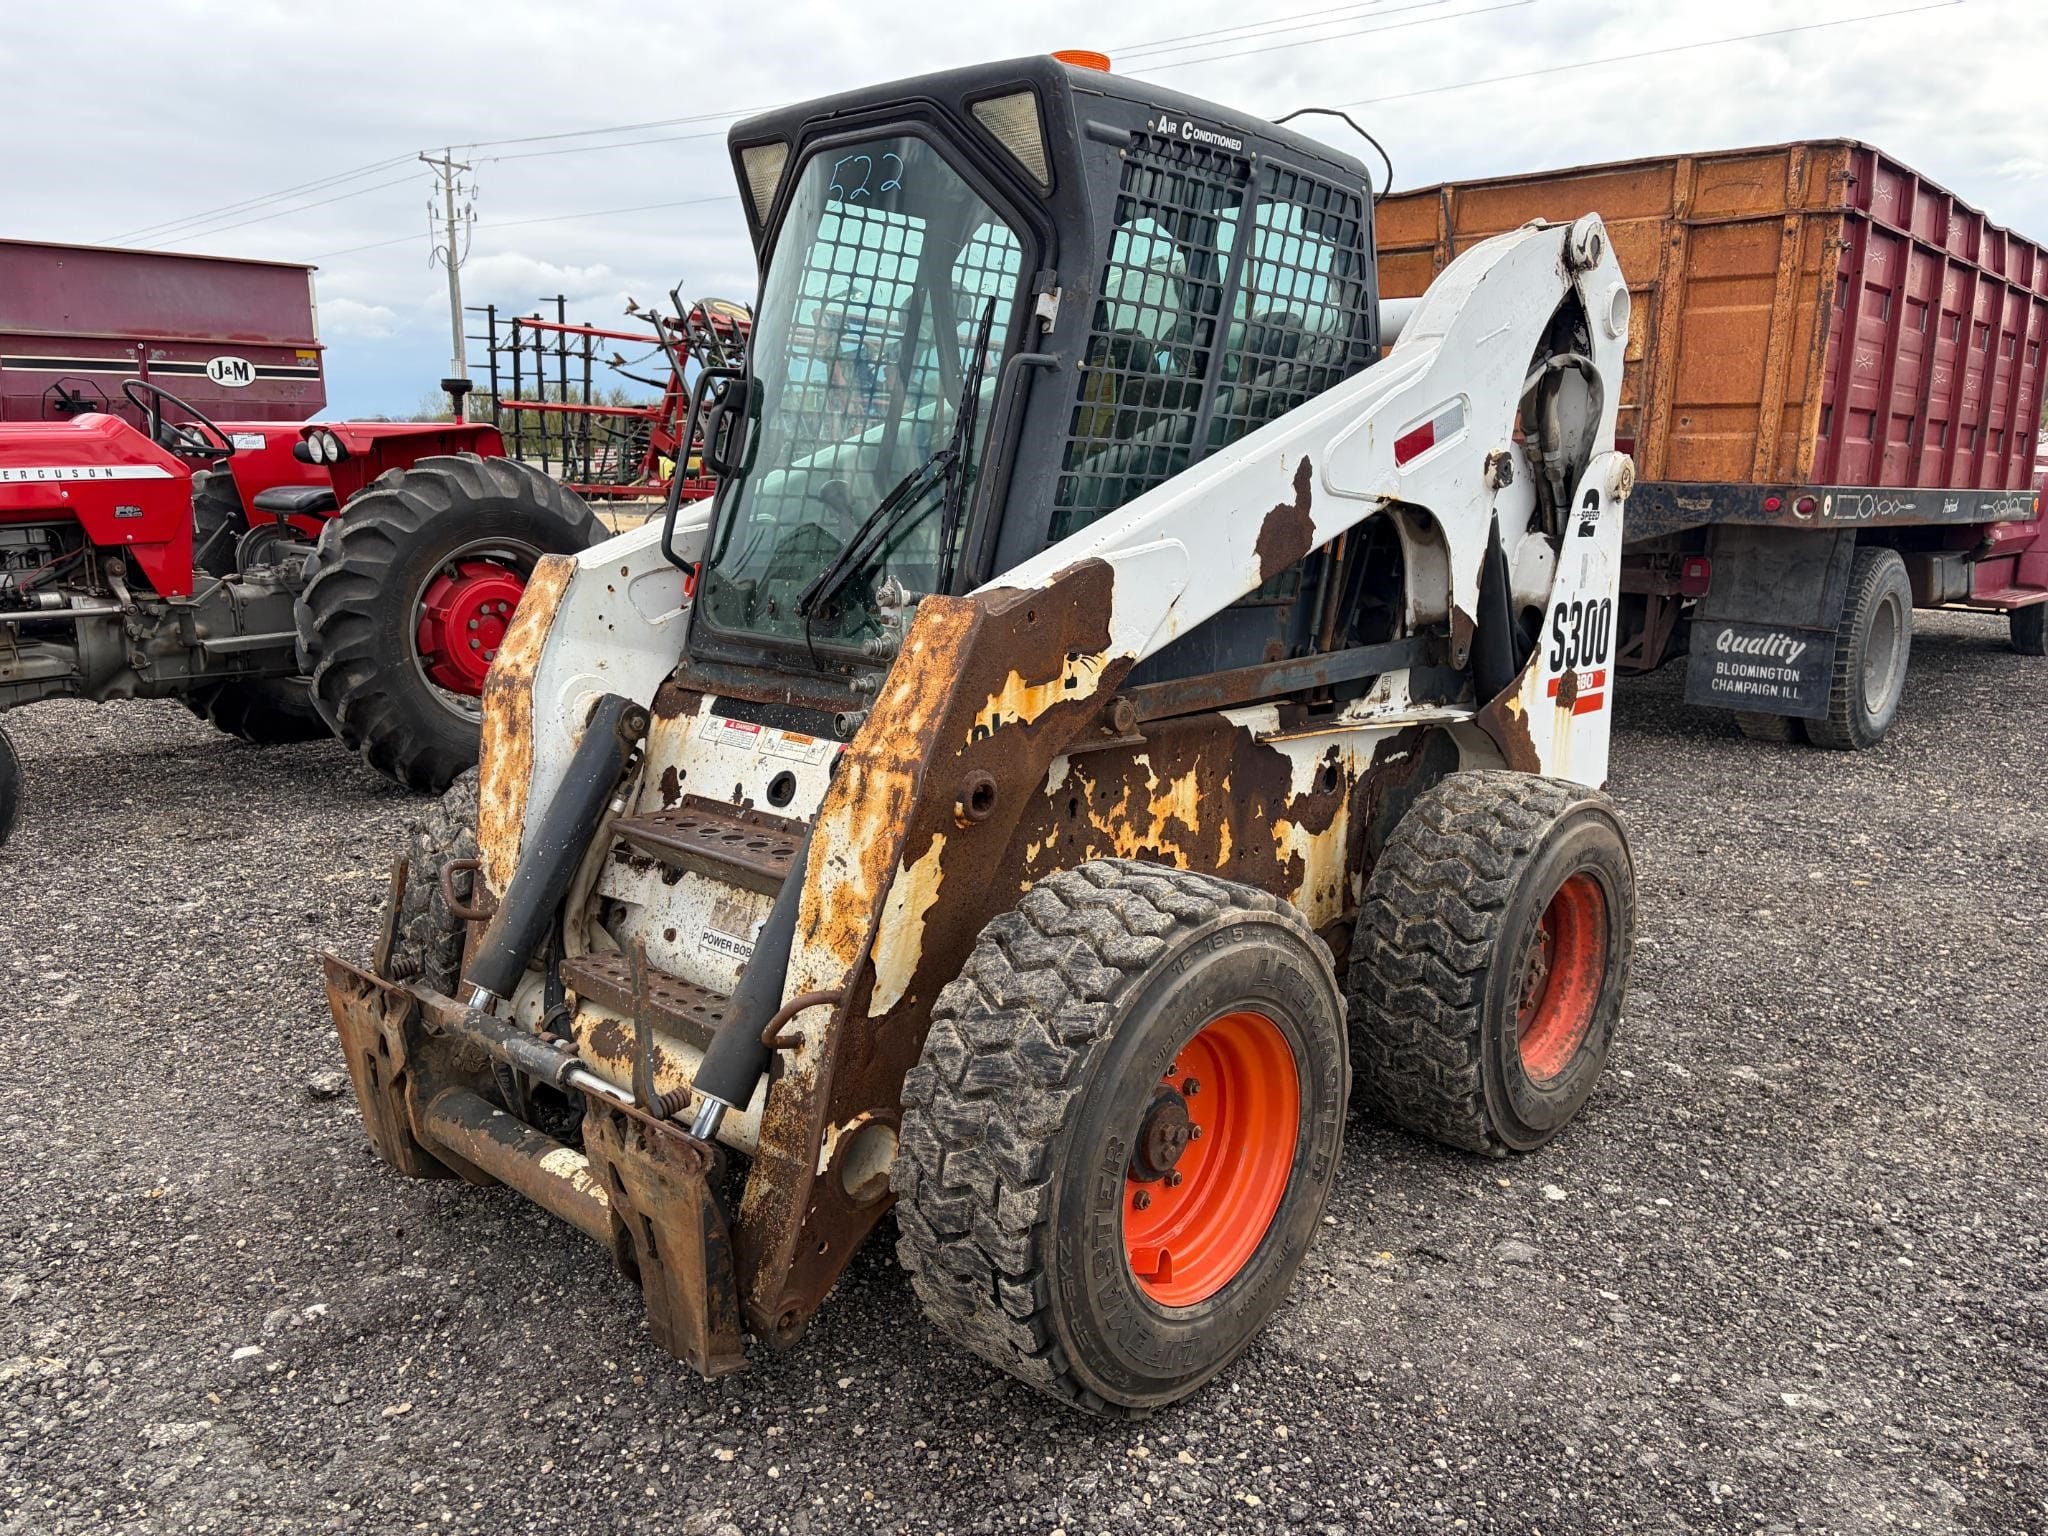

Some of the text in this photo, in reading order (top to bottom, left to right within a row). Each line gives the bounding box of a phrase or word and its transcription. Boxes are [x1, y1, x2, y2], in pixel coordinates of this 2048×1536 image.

[1157, 115, 1242, 151] AIR CONDITIONED
[829, 153, 904, 209] 522
[210, 360, 250, 381] J&M
[1577, 488, 1600, 538] 2
[1550, 597, 1611, 673] S300
[1716, 628, 1807, 665] Quality
[1716, 661, 1800, 682] BLOOMINGTON
[702, 932, 733, 952] POWER
[1171, 927, 1244, 975] 12-16.5
[1092, 1135, 1201, 1371] LIFEMASTER
